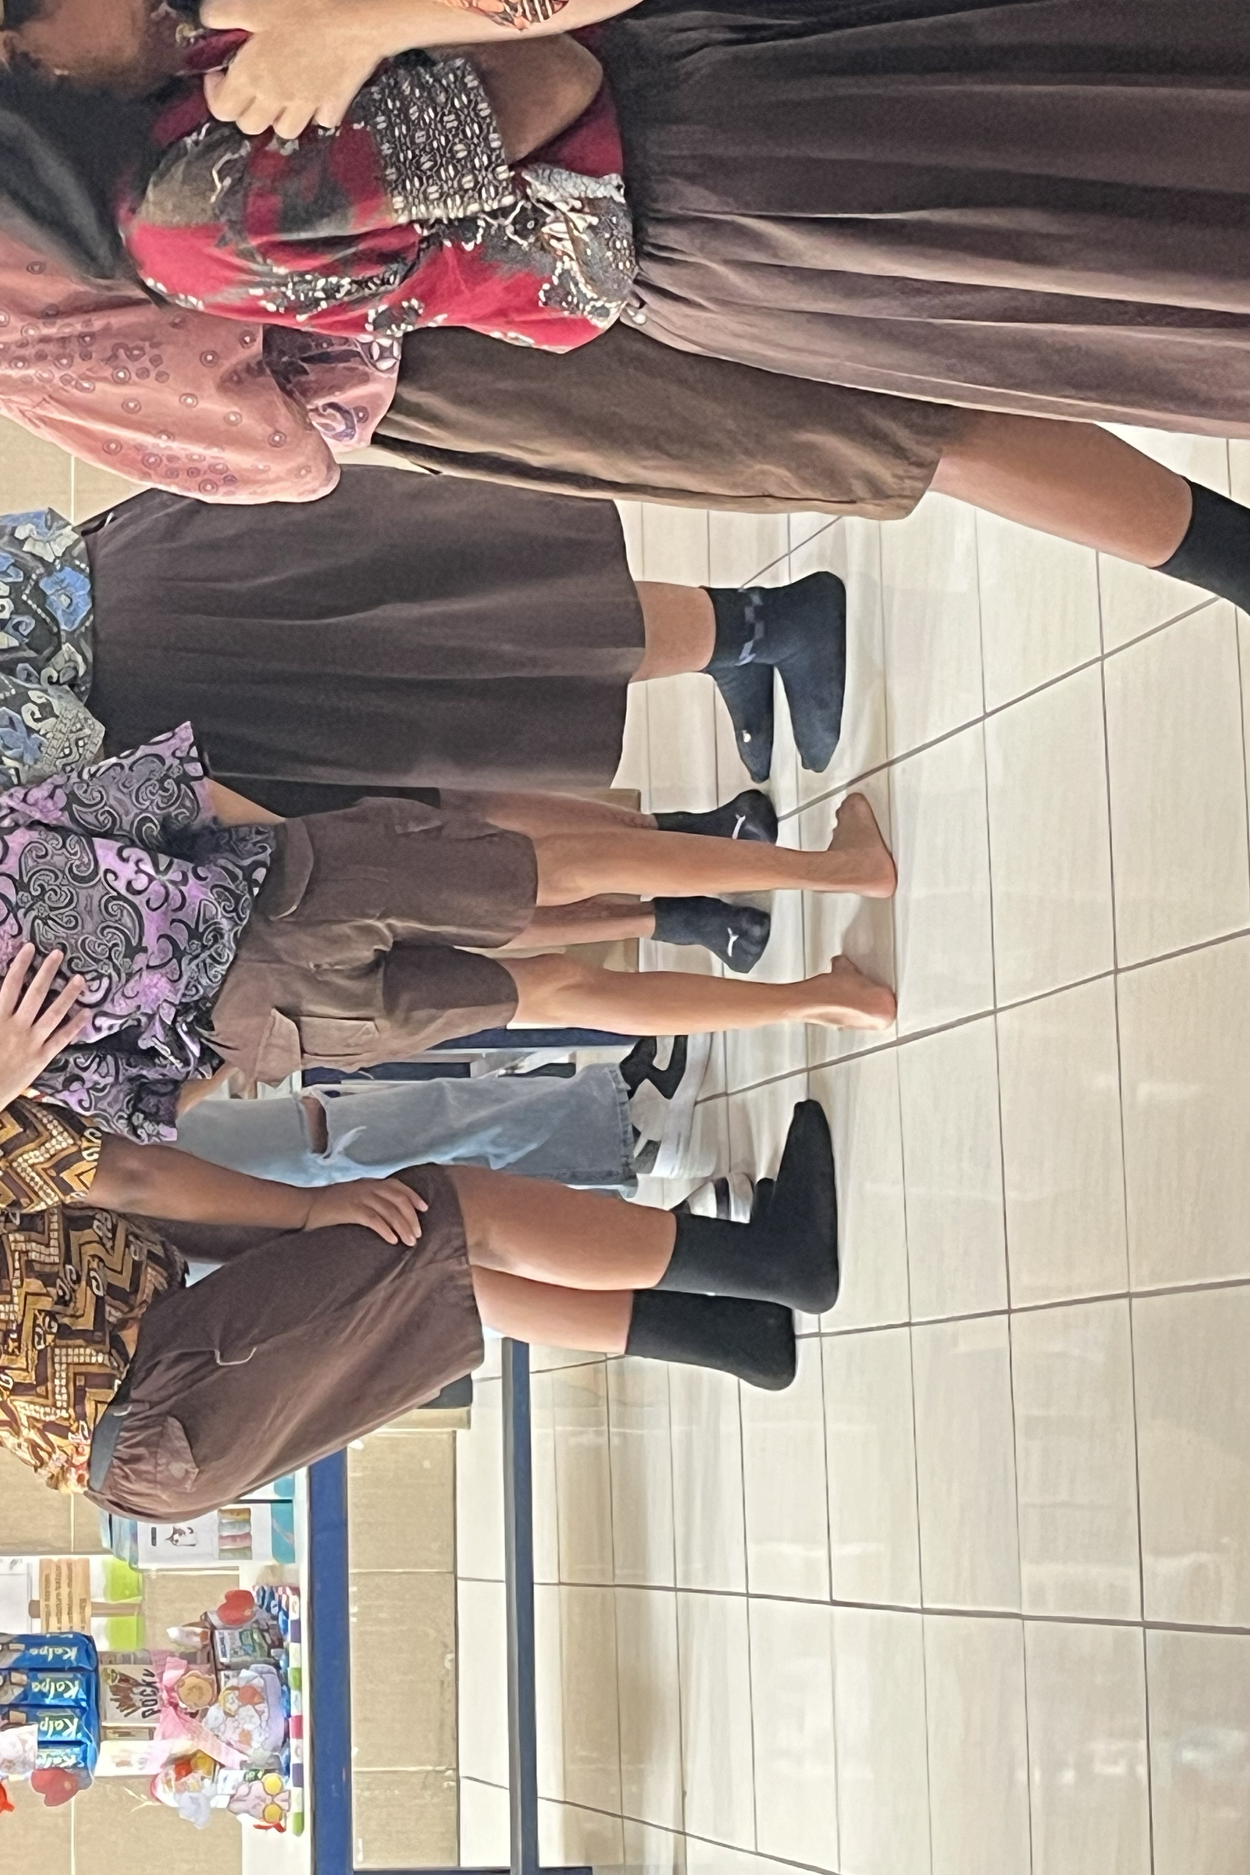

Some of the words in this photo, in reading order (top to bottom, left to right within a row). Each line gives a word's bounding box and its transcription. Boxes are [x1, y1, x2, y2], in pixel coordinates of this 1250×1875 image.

[30, 1645, 78, 1662] Kalpa
[31, 1677, 79, 1702] Kalpa
[141, 1668, 161, 1718] POCKY
[39, 1717, 79, 1737] Kalp
